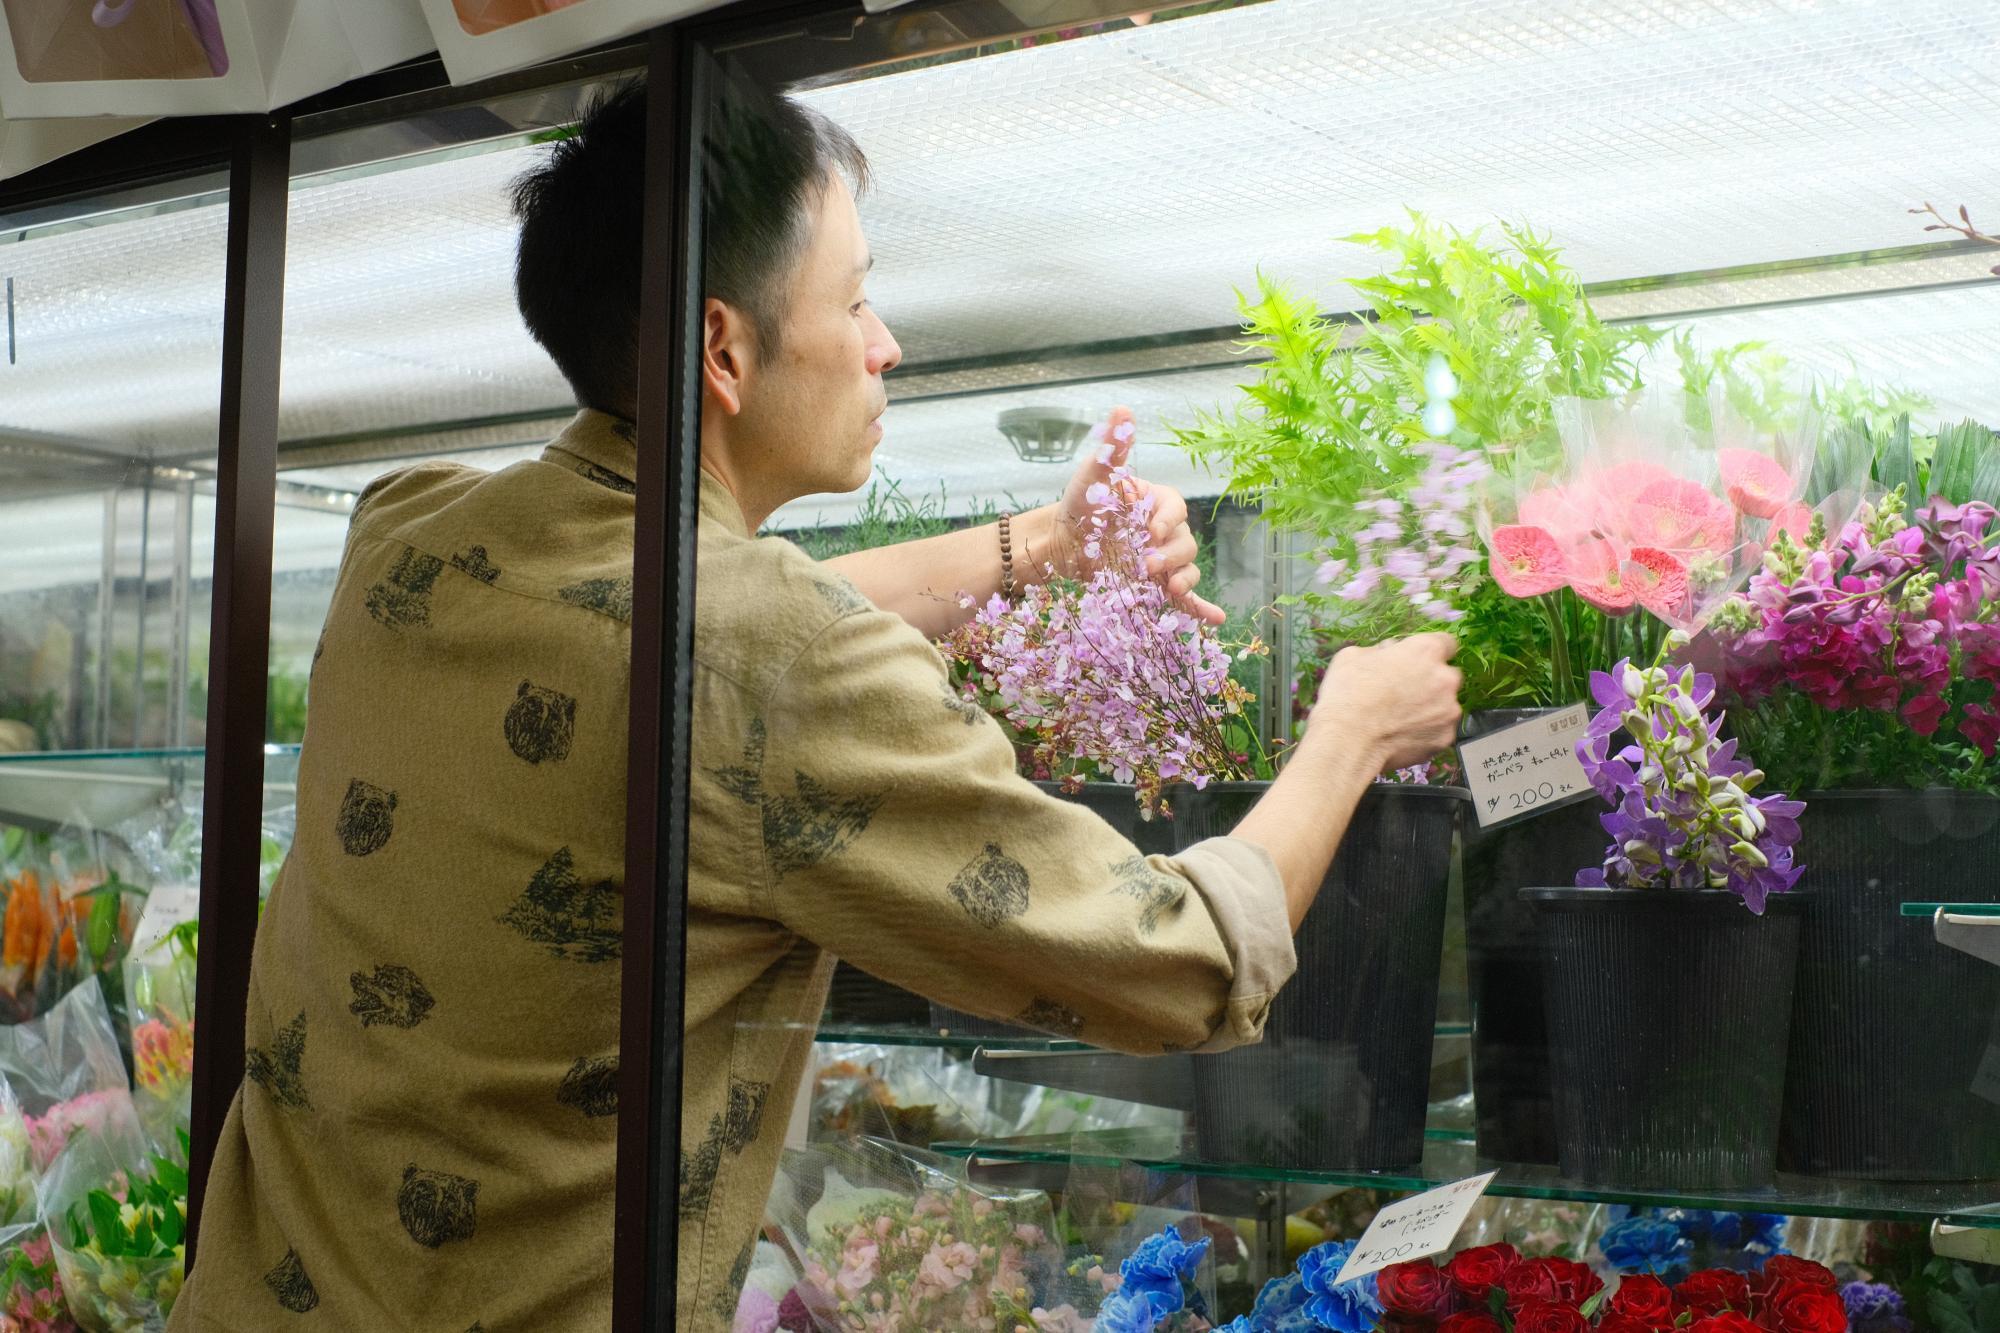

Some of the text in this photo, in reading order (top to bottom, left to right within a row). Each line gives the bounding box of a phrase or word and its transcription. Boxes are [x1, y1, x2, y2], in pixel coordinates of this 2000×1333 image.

[1487, 761, 1523, 782] ガーベラ
[1510, 782, 1553, 808] 200
[1369, 1242, 1413, 1264] 200
